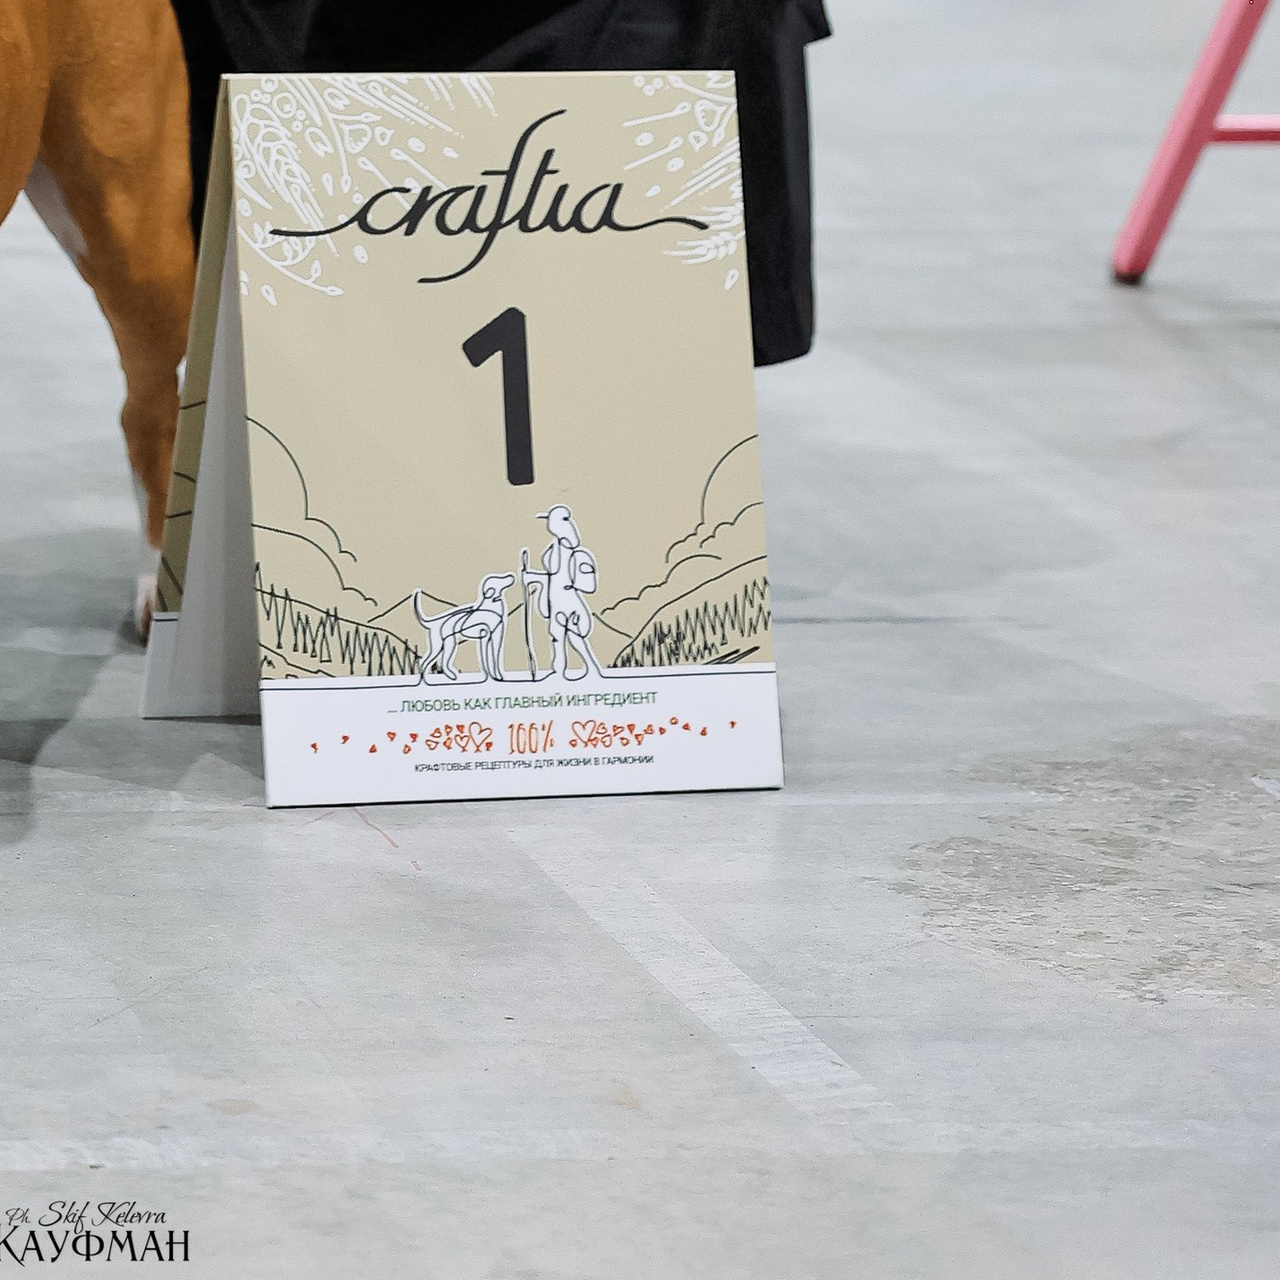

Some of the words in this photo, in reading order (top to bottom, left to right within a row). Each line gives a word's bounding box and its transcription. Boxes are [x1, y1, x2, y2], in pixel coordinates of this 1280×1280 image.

[271, 109, 709, 283] craftia
[463, 307, 534, 486] 1
[400, 698, 461, 712] ЛЮБОВЬ
[464, 697, 491, 711] КАК
[495, 693, 564, 709] ГЛАВНЫЙ
[566, 691, 658, 708] ИНГРЕДИЕНТ
[508, 720, 555, 755] 100%
[414, 761, 473, 772] КРАФТОВЫЕ
[474, 759, 532, 771] РЕЦЕПТУРЫ
[534, 758, 554, 769] ДЛЯ
